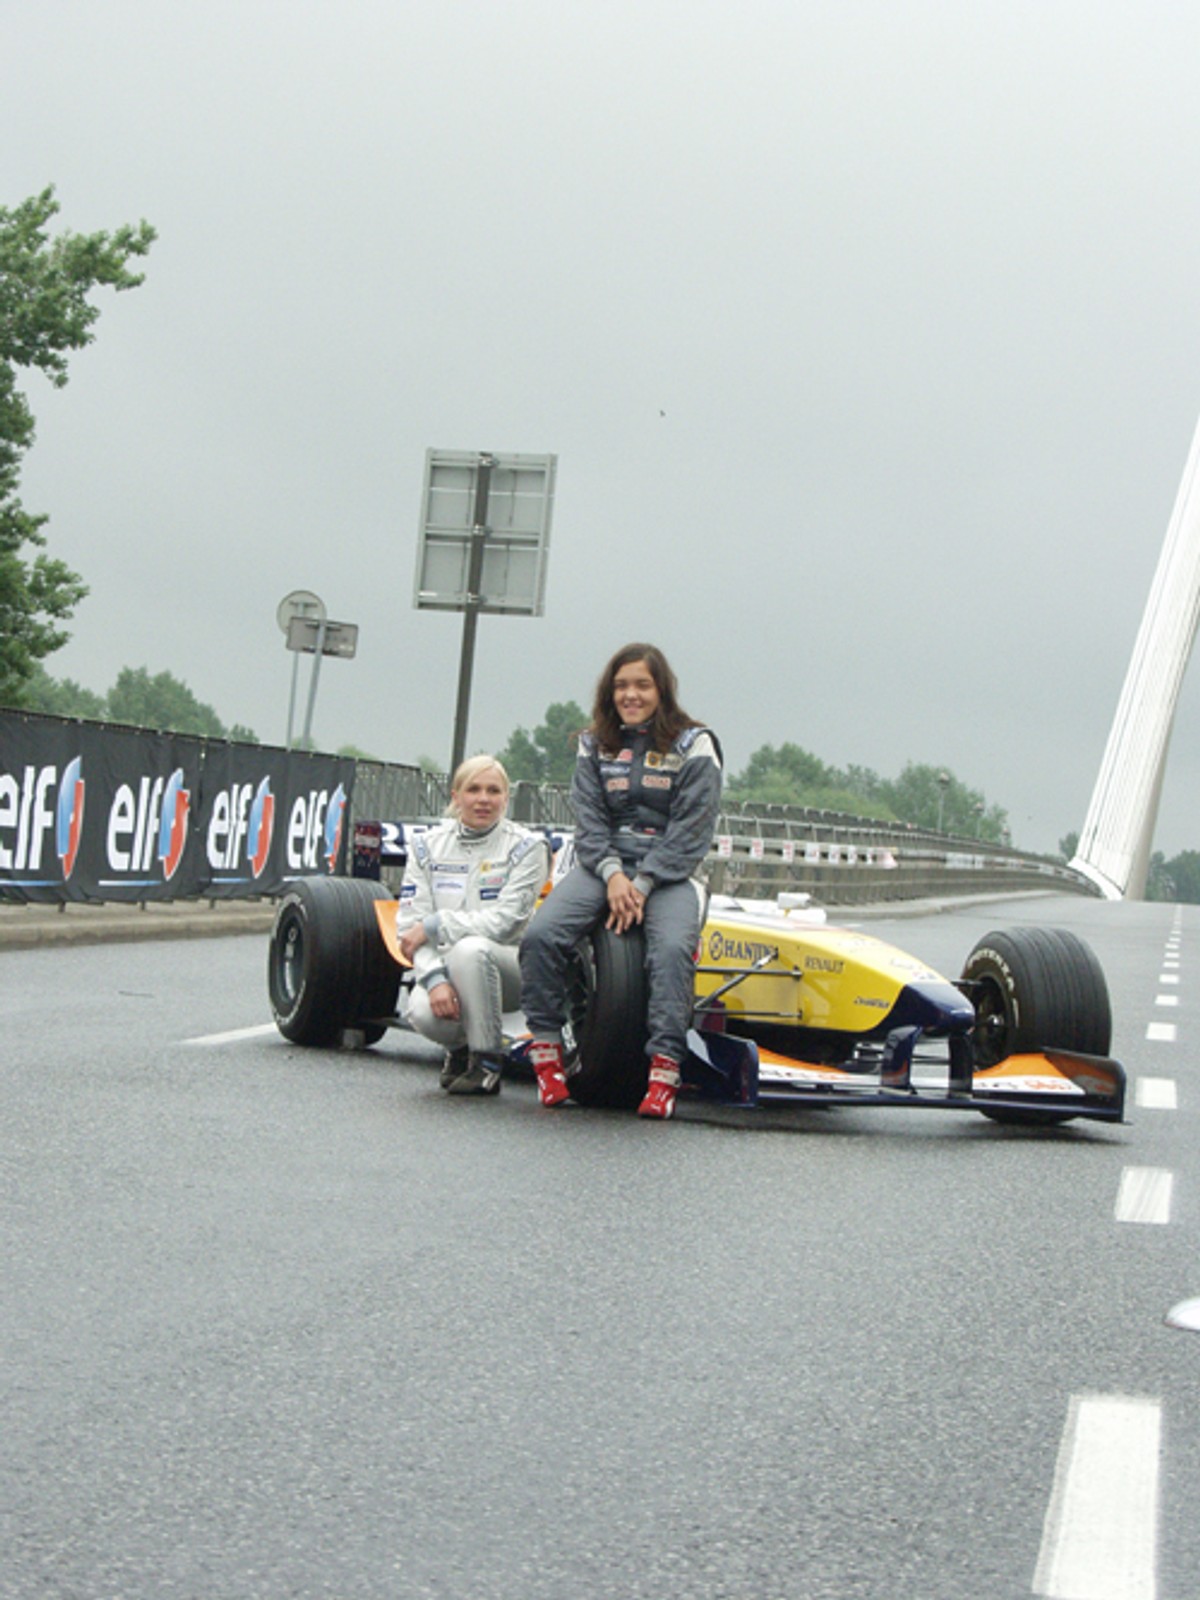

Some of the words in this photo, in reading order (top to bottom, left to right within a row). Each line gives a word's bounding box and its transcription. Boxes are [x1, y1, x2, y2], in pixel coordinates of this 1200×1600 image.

[106, 776, 164, 871] elf
[206, 783, 254, 869] elf
[287, 789, 328, 869] elf
[804, 955, 845, 974] RENAULT
